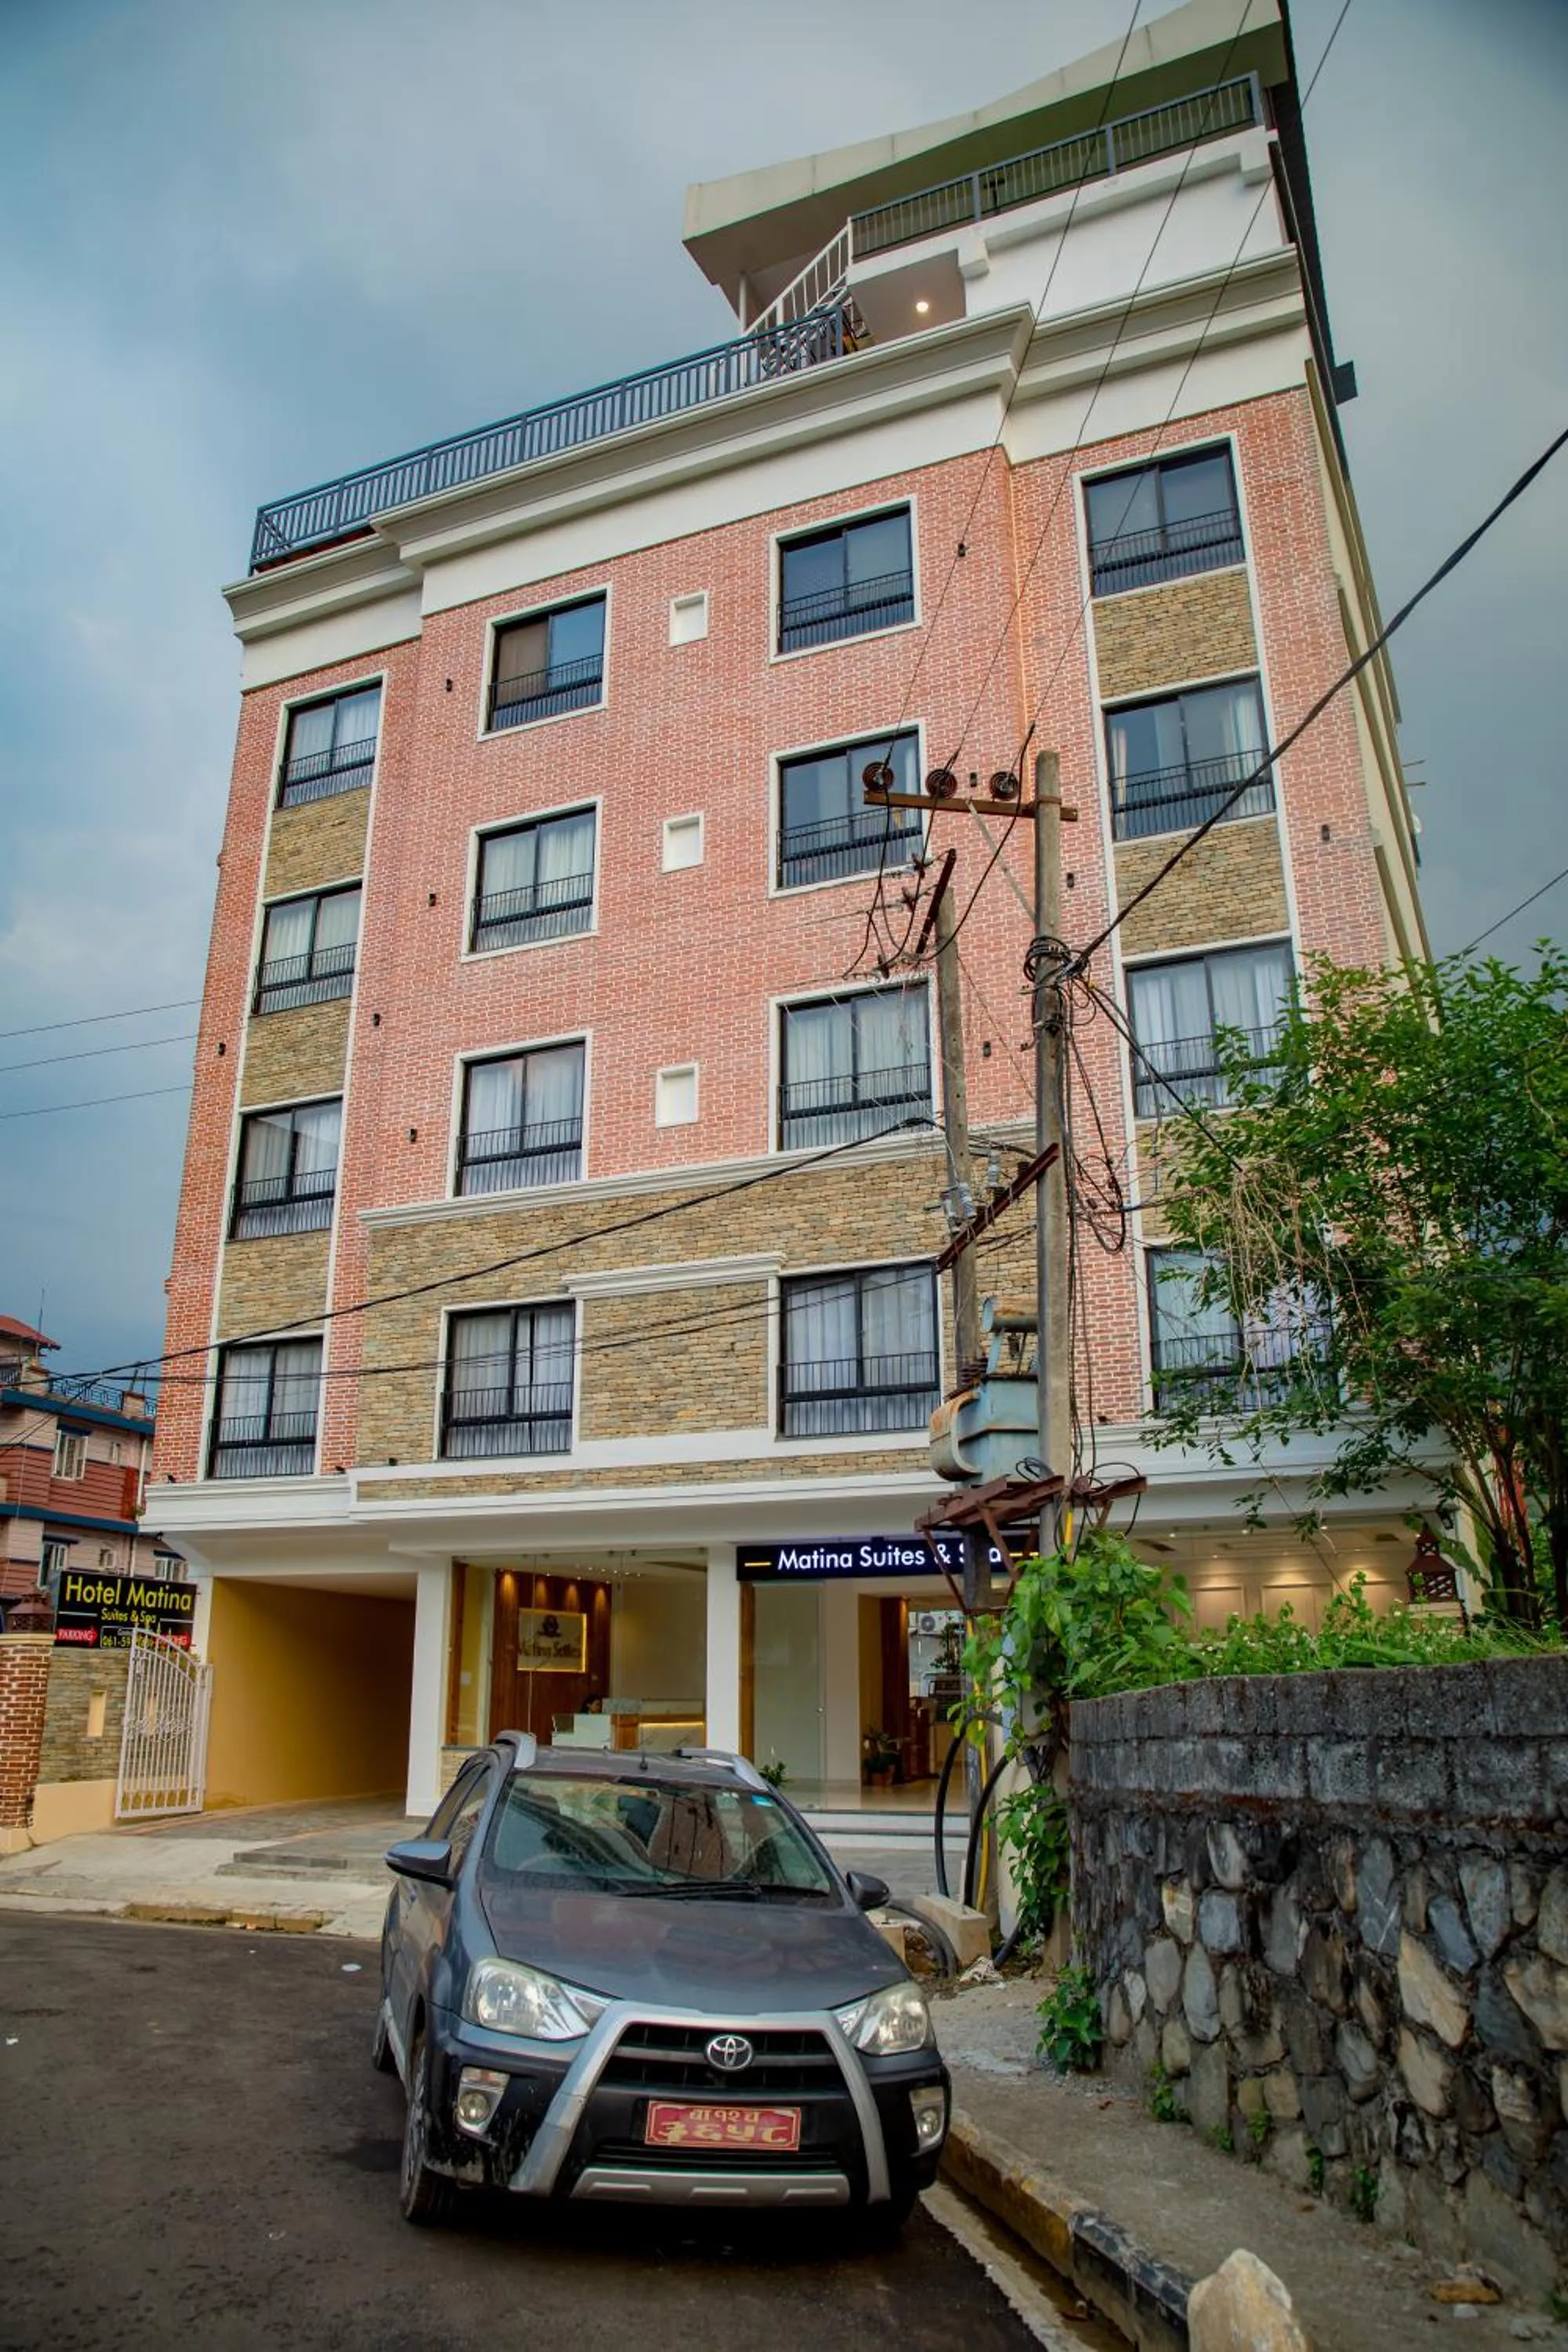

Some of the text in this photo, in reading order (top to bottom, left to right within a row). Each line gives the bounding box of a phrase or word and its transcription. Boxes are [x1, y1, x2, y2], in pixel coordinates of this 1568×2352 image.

[778, 1549, 852, 1570] Matina
[859, 1545, 925, 1567] Suites
[934, 1544, 951, 1564] &
[65, 1575, 192, 1610] Hotel Matina
[101, 1608, 157, 1625] Suites & Spa
[57, 1628, 93, 1642] PARKING
